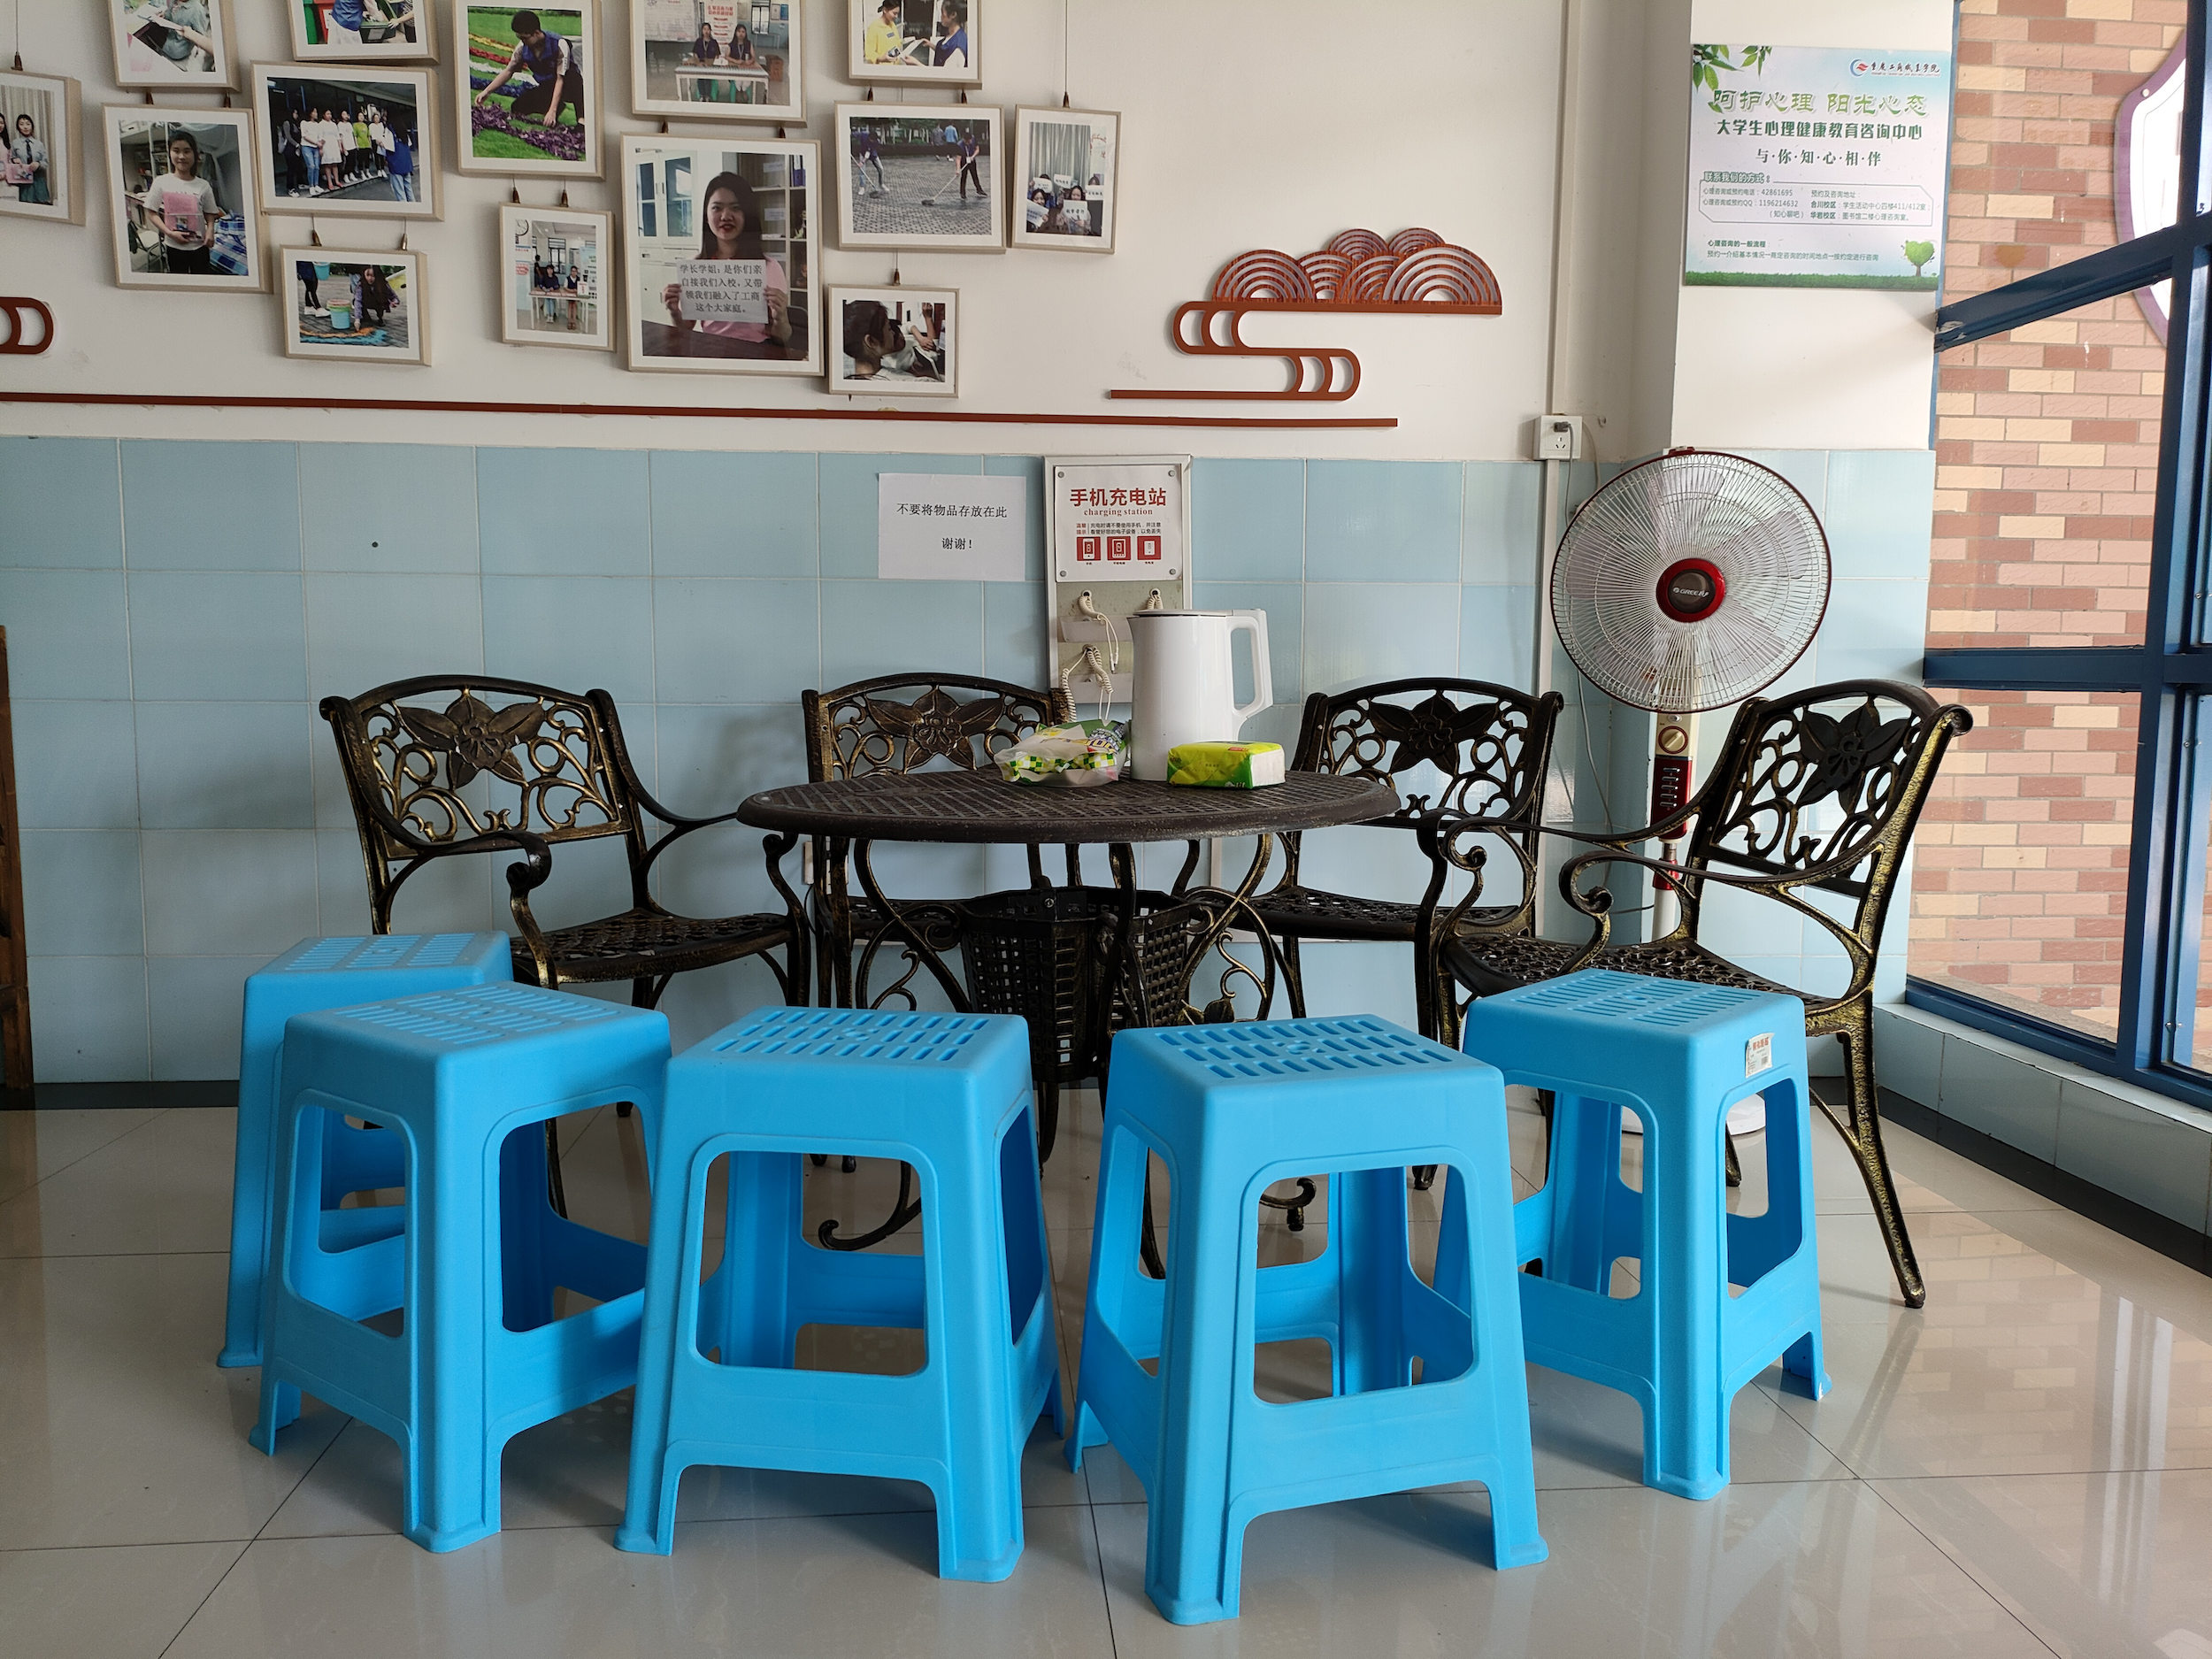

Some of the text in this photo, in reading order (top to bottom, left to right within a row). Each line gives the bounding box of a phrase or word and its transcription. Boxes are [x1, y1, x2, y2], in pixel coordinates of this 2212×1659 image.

[1713, 89, 1928, 117] 呵护心理 阳光心态
[1717, 119, 1923, 140] 大学生心理健康教育咨询中心
[1069, 487, 1167, 507] 手机充电站
[896, 503, 1008, 518] 不要将物品存放在此
[1084, 507, 1153, 518] charging station
[941, 537, 972, 550] 谢谢！
